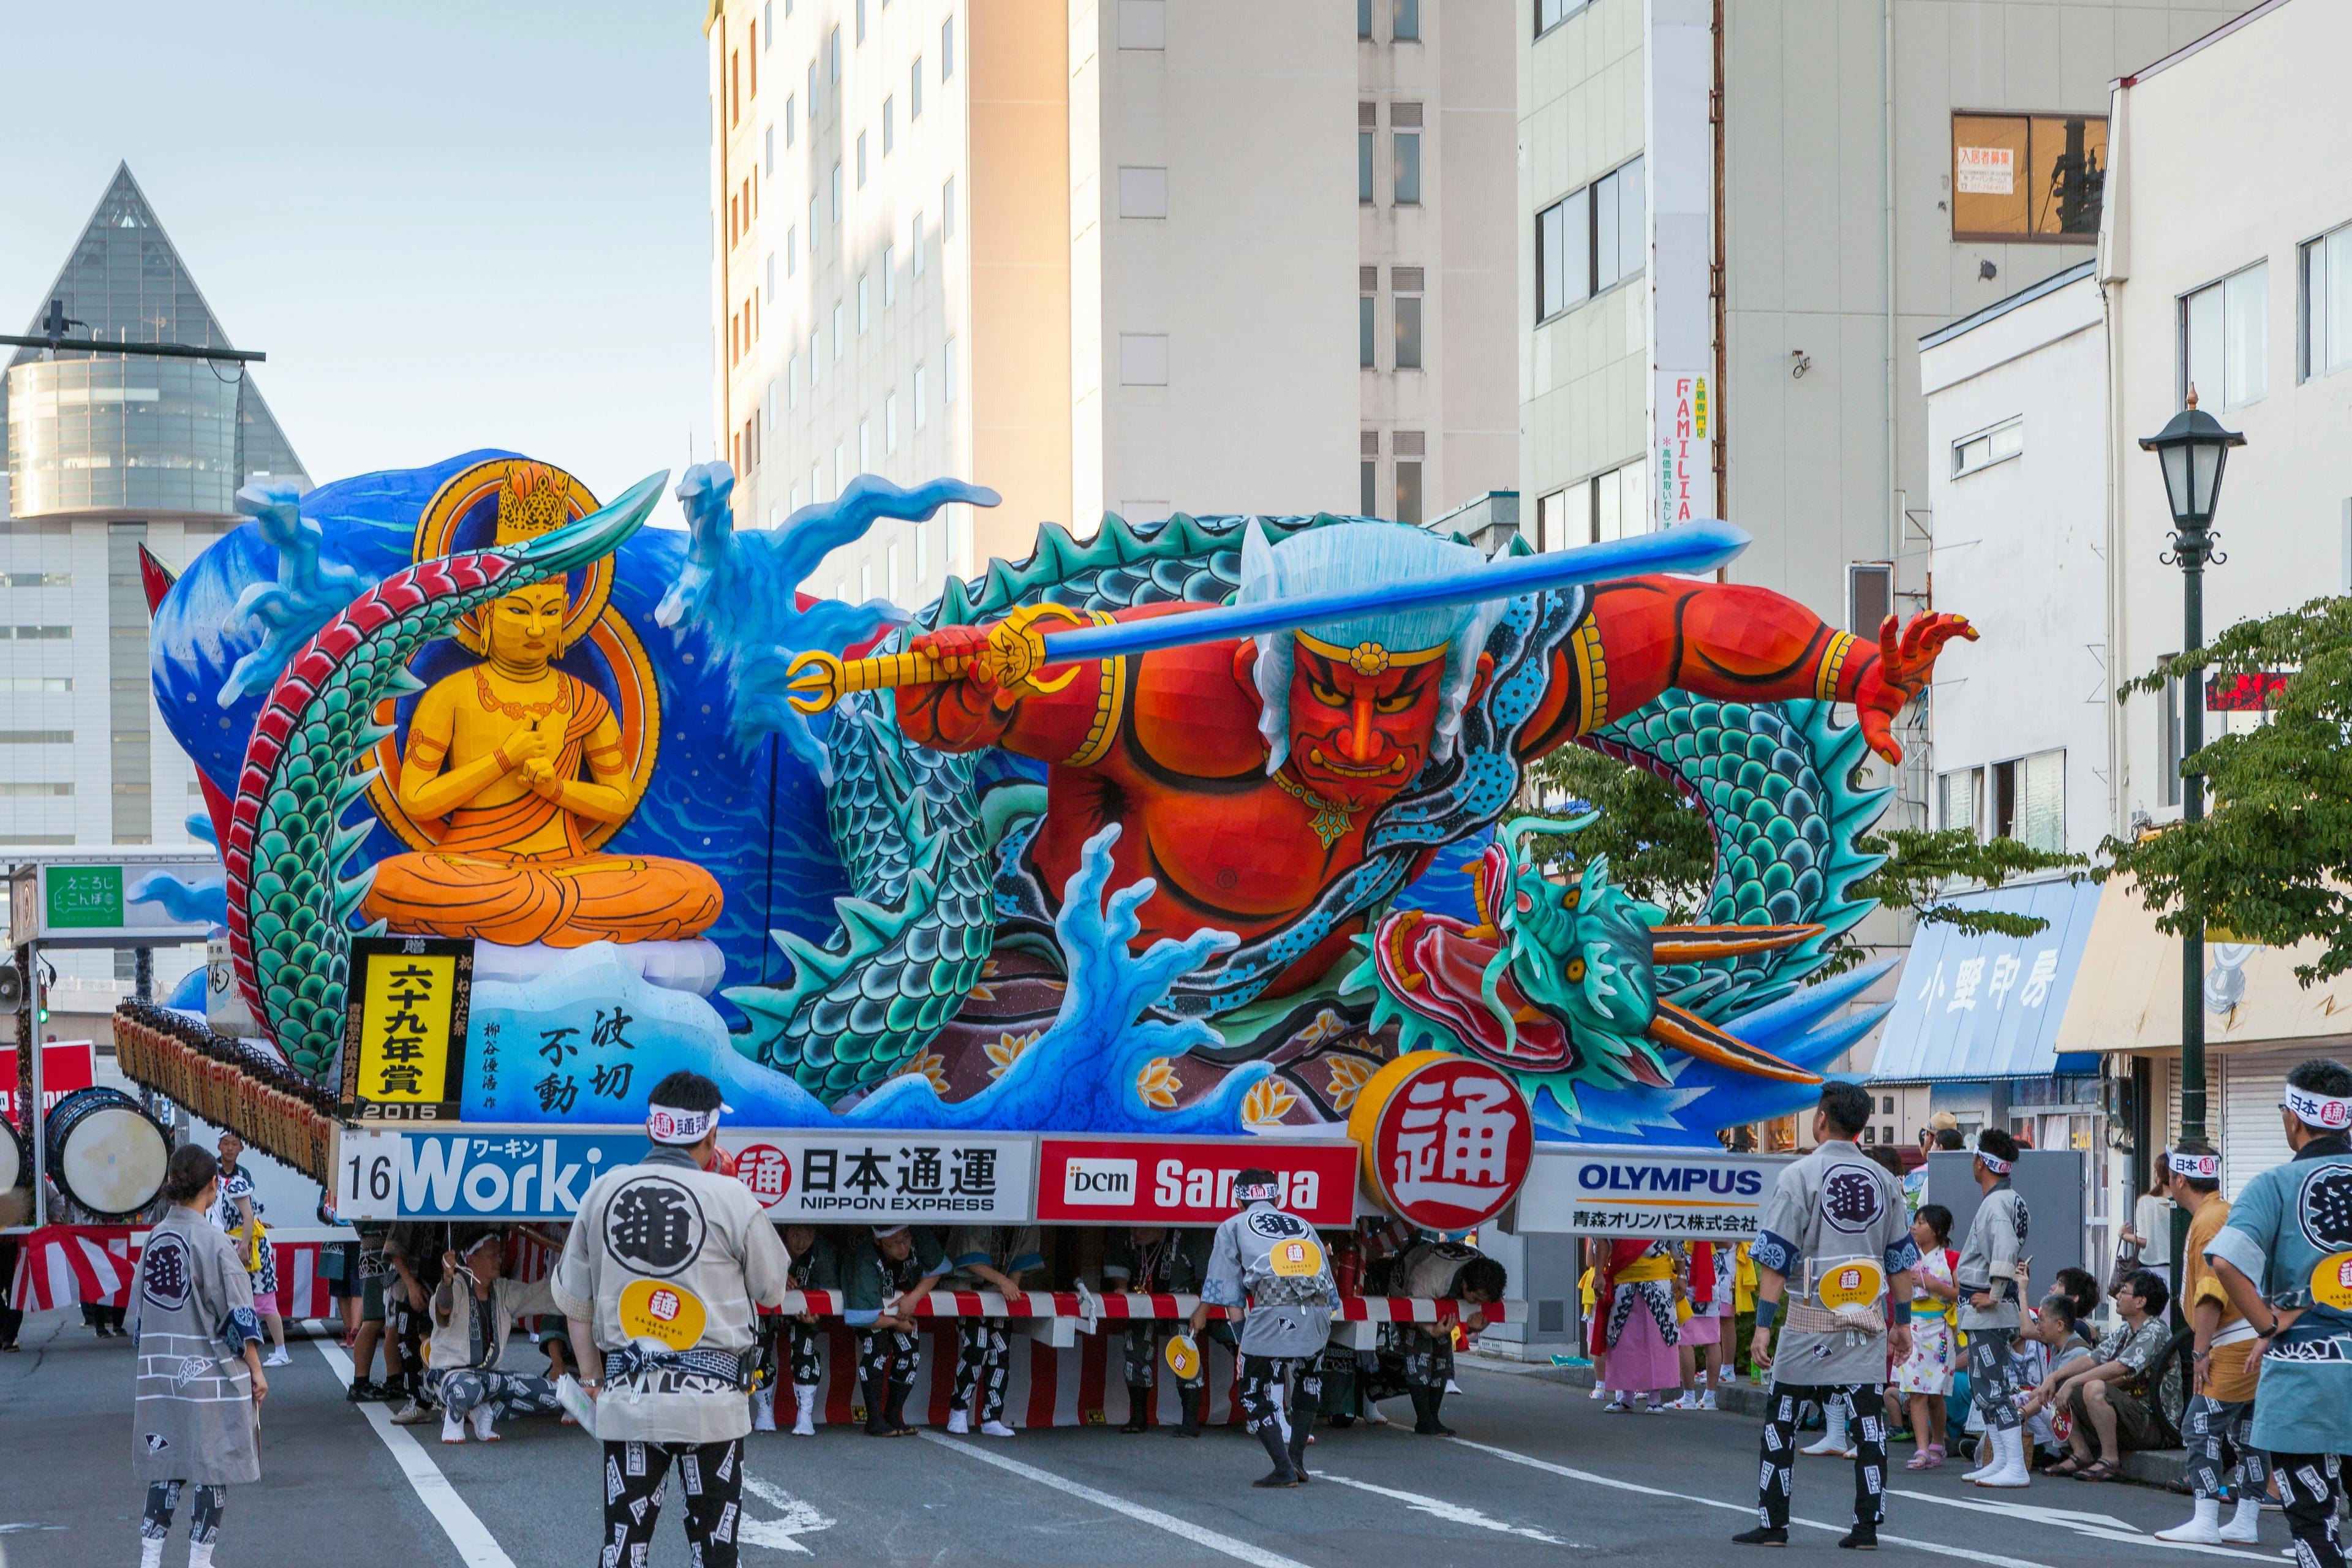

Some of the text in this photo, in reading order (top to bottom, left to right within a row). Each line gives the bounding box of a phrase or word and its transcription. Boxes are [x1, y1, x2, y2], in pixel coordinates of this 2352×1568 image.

[1962, 149, 2009, 164] 入居者募集
[1677, 379, 1691, 525] FAMILIA
[67, 875, 113, 889] えころじ
[458, 954, 472, 971] 祝
[377, 963, 433, 1095] 六十九年賞
[588, 1006, 635, 1101] 波切
[533, 1027, 580, 1114] 不動
[362, 1104, 437, 1120] 2015
[2290, 1092, 2318, 1117] 日本
[473, 1139, 538, 1158] ワーキン
[800, 1147, 997, 1196] 日本通運
[2176, 1158, 2198, 1172] 日本
[349, 1155, 391, 1200] 16
[1578, 1164, 1762, 1196] OLYMPUS
[800, 1197, 994, 1212] NIPPON EXPRESS
[1572, 1210, 1758, 1232] 青森オリンパス株式会社
